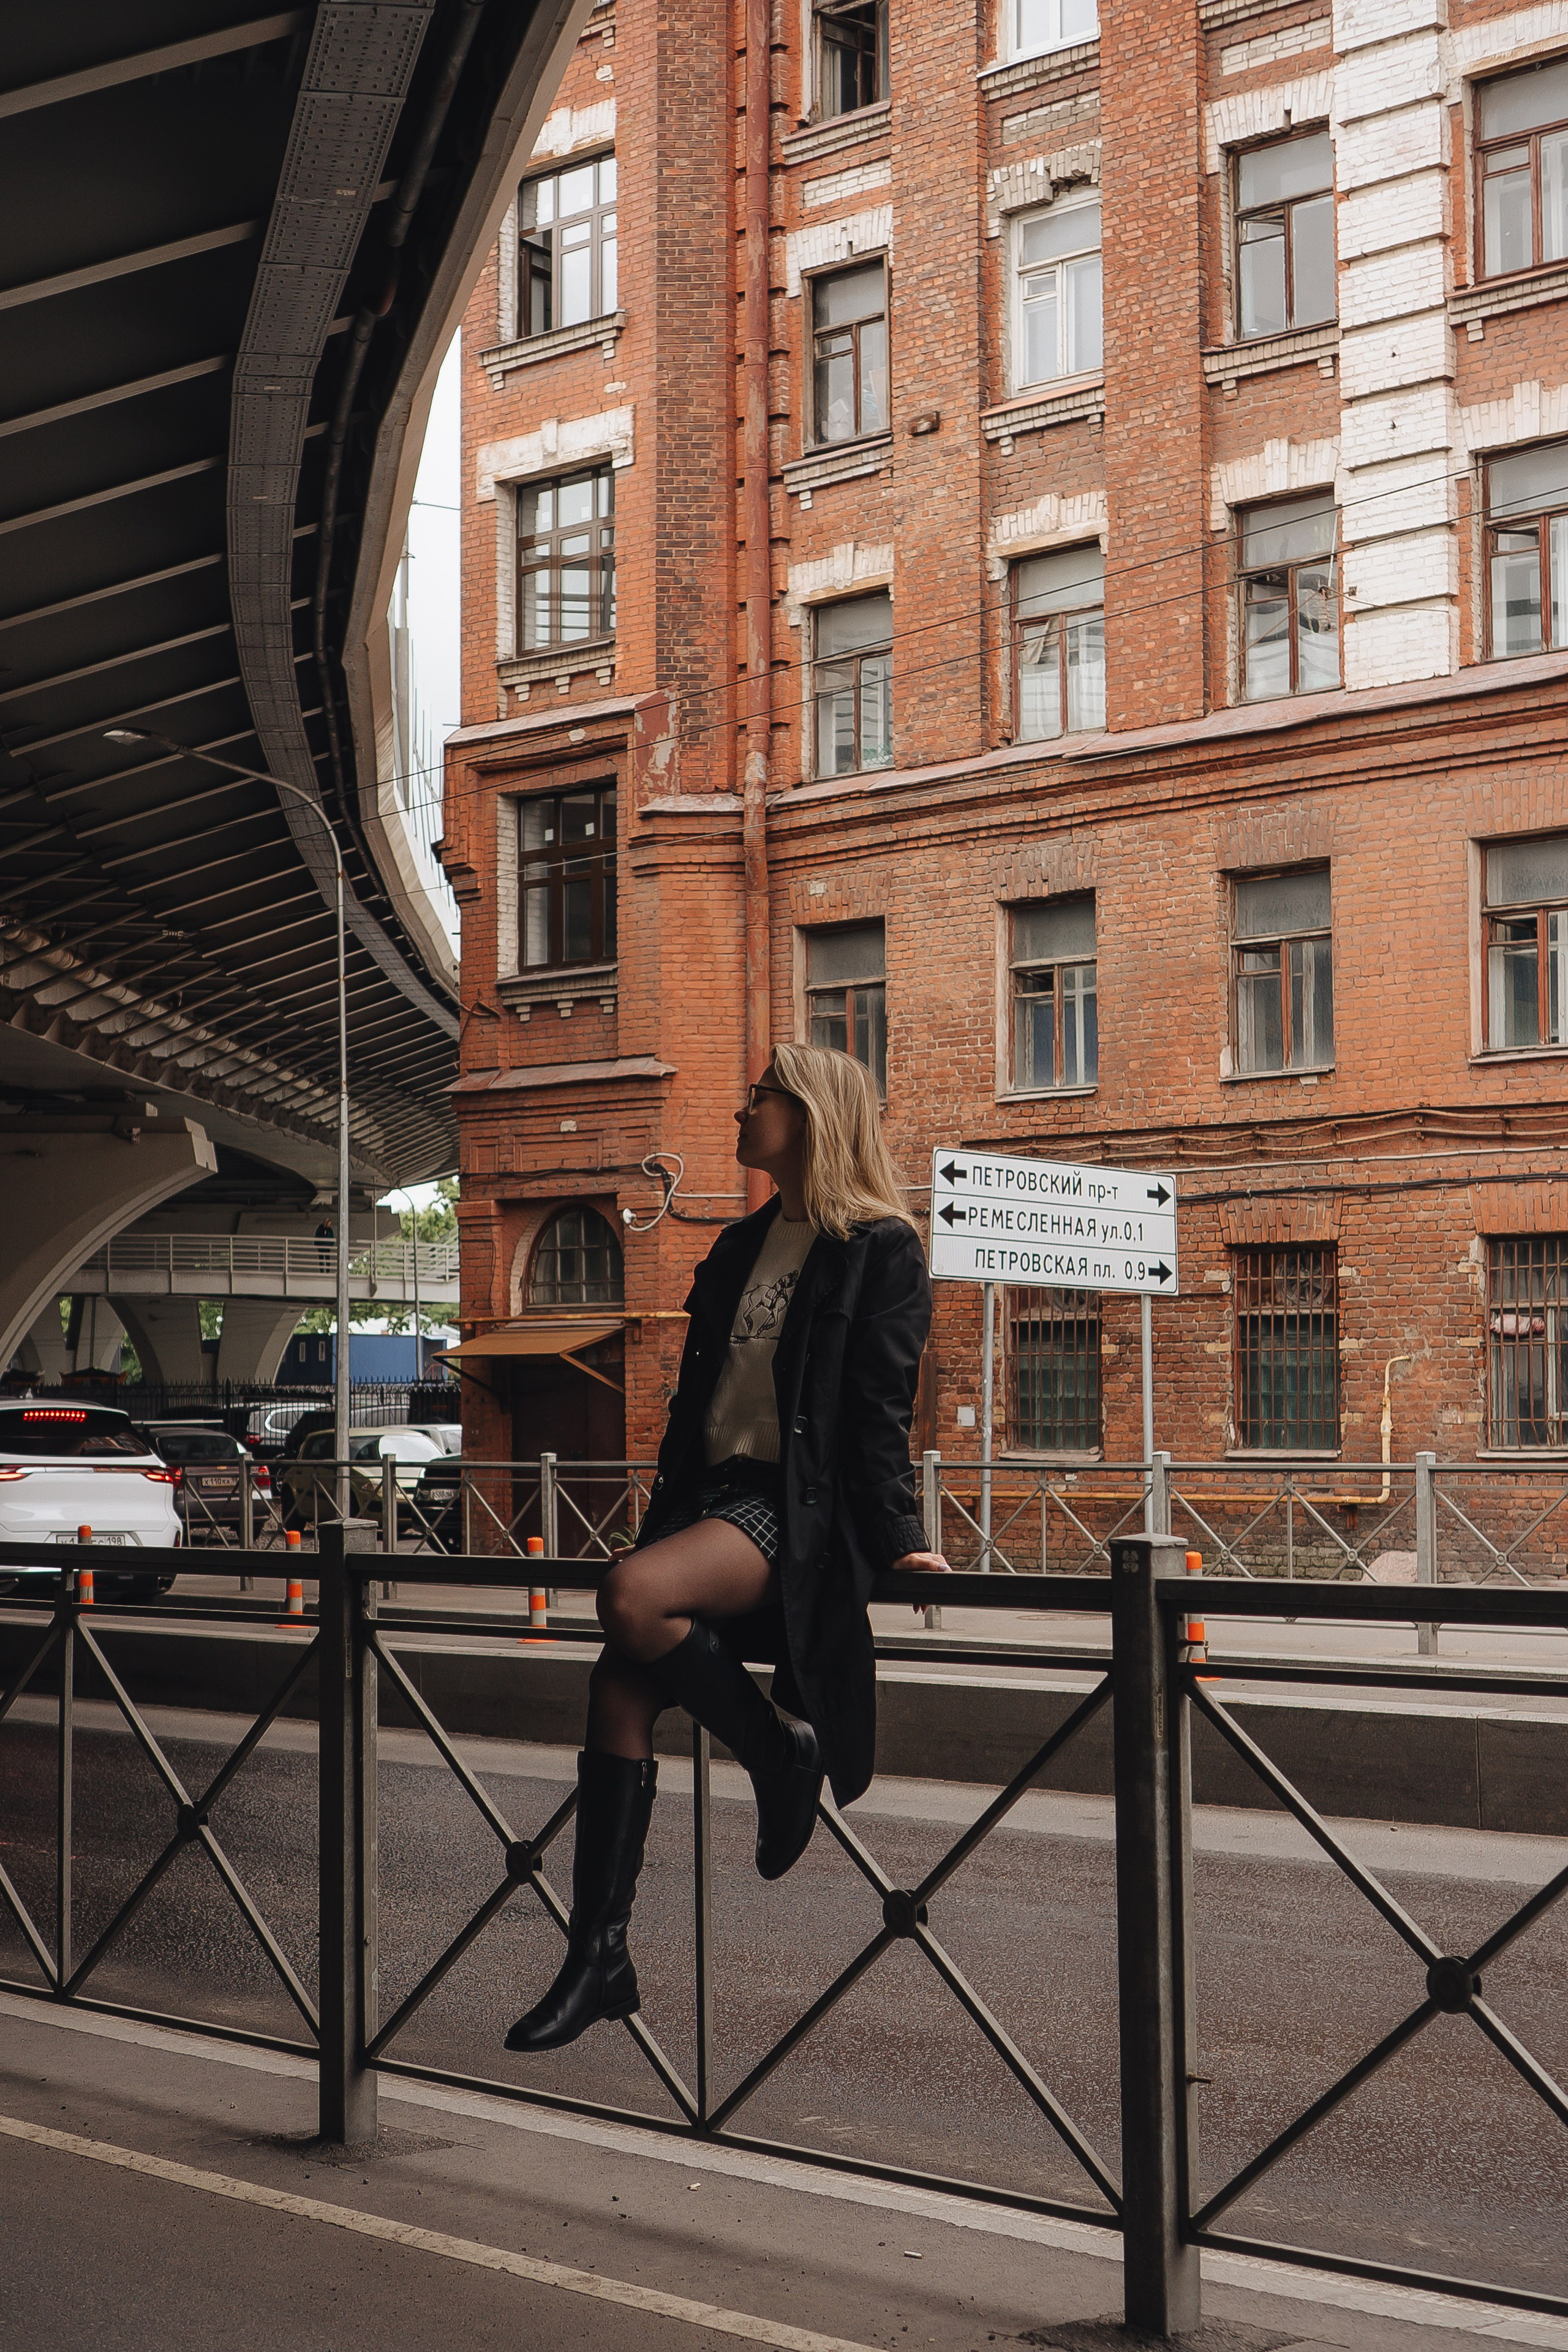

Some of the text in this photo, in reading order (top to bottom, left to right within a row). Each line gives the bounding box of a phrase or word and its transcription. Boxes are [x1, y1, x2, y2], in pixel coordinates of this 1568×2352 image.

[972, 1166, 1119, 1204] ПЕТРОВСКИЙ пр-т
[968, 1206, 1096, 1238] РЕМЕСЛЕННАЯ
[975, 1248, 1146, 1281] ПЕТРОВСКАЯ пл. 0,9
